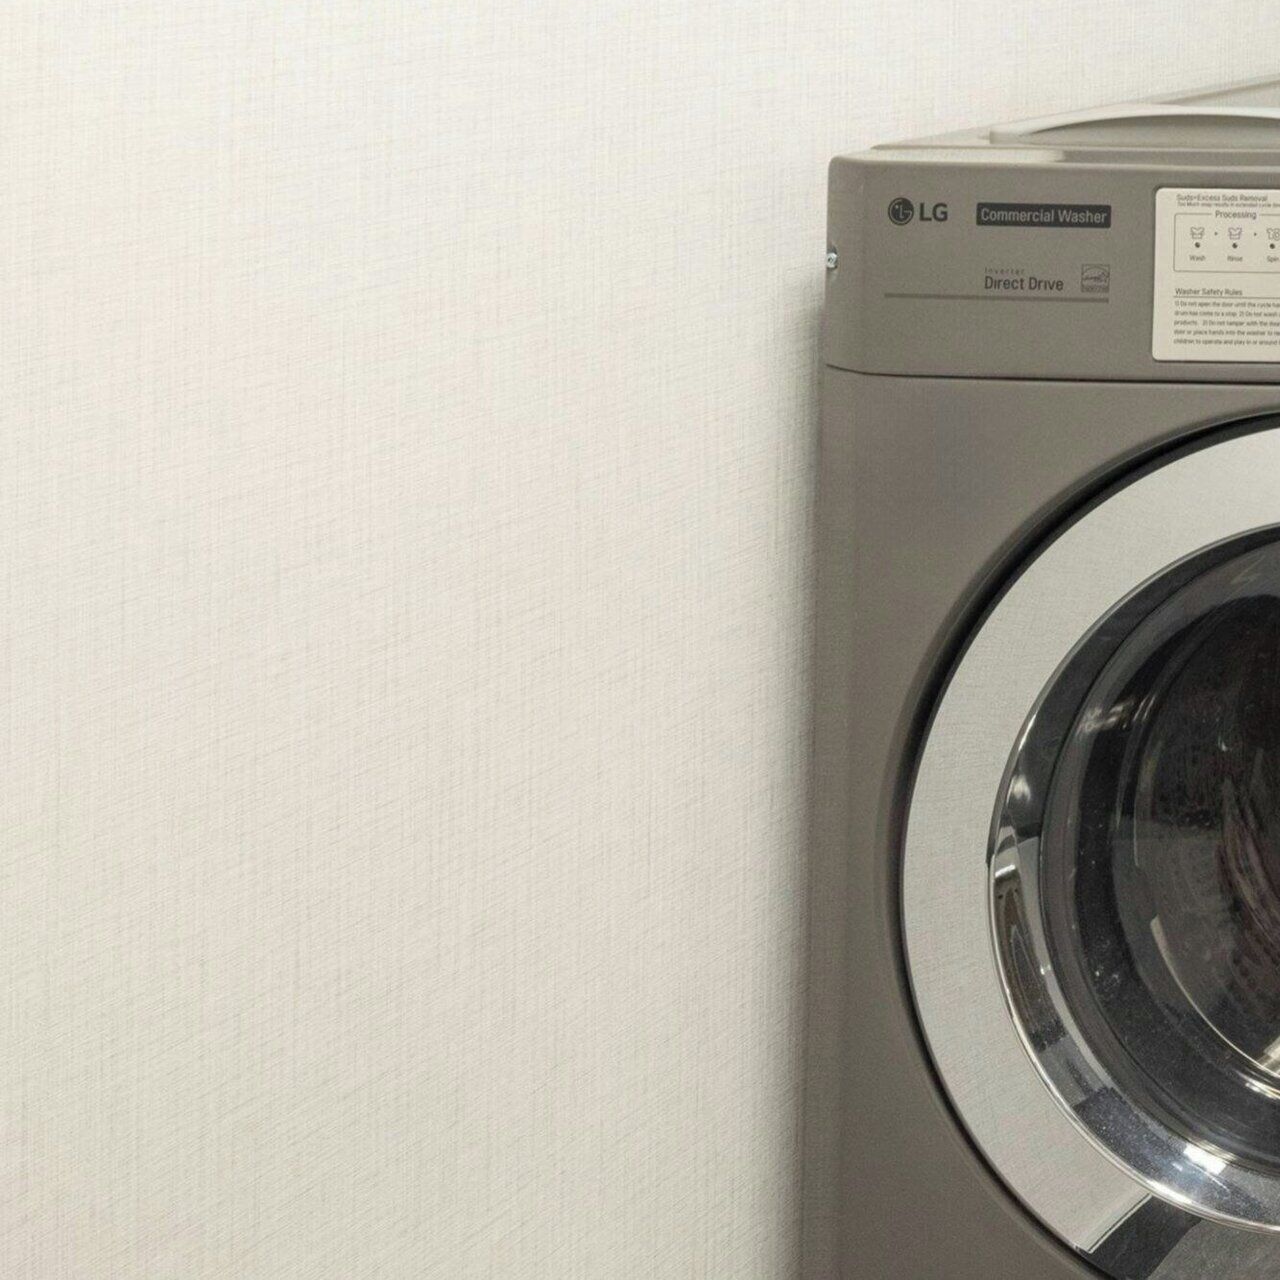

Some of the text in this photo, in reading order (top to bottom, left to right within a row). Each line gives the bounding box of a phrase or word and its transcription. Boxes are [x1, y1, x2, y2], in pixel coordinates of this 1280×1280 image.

[919, 203, 948, 222] LG
[980, 207, 1108, 224] Commercial Washer
[1215, 210, 1257, 220] Processing
[984, 276, 1025, 290] Direct
[1028, 276, 1064, 291] Drive
[1202, 288, 1223, 296] Safety
